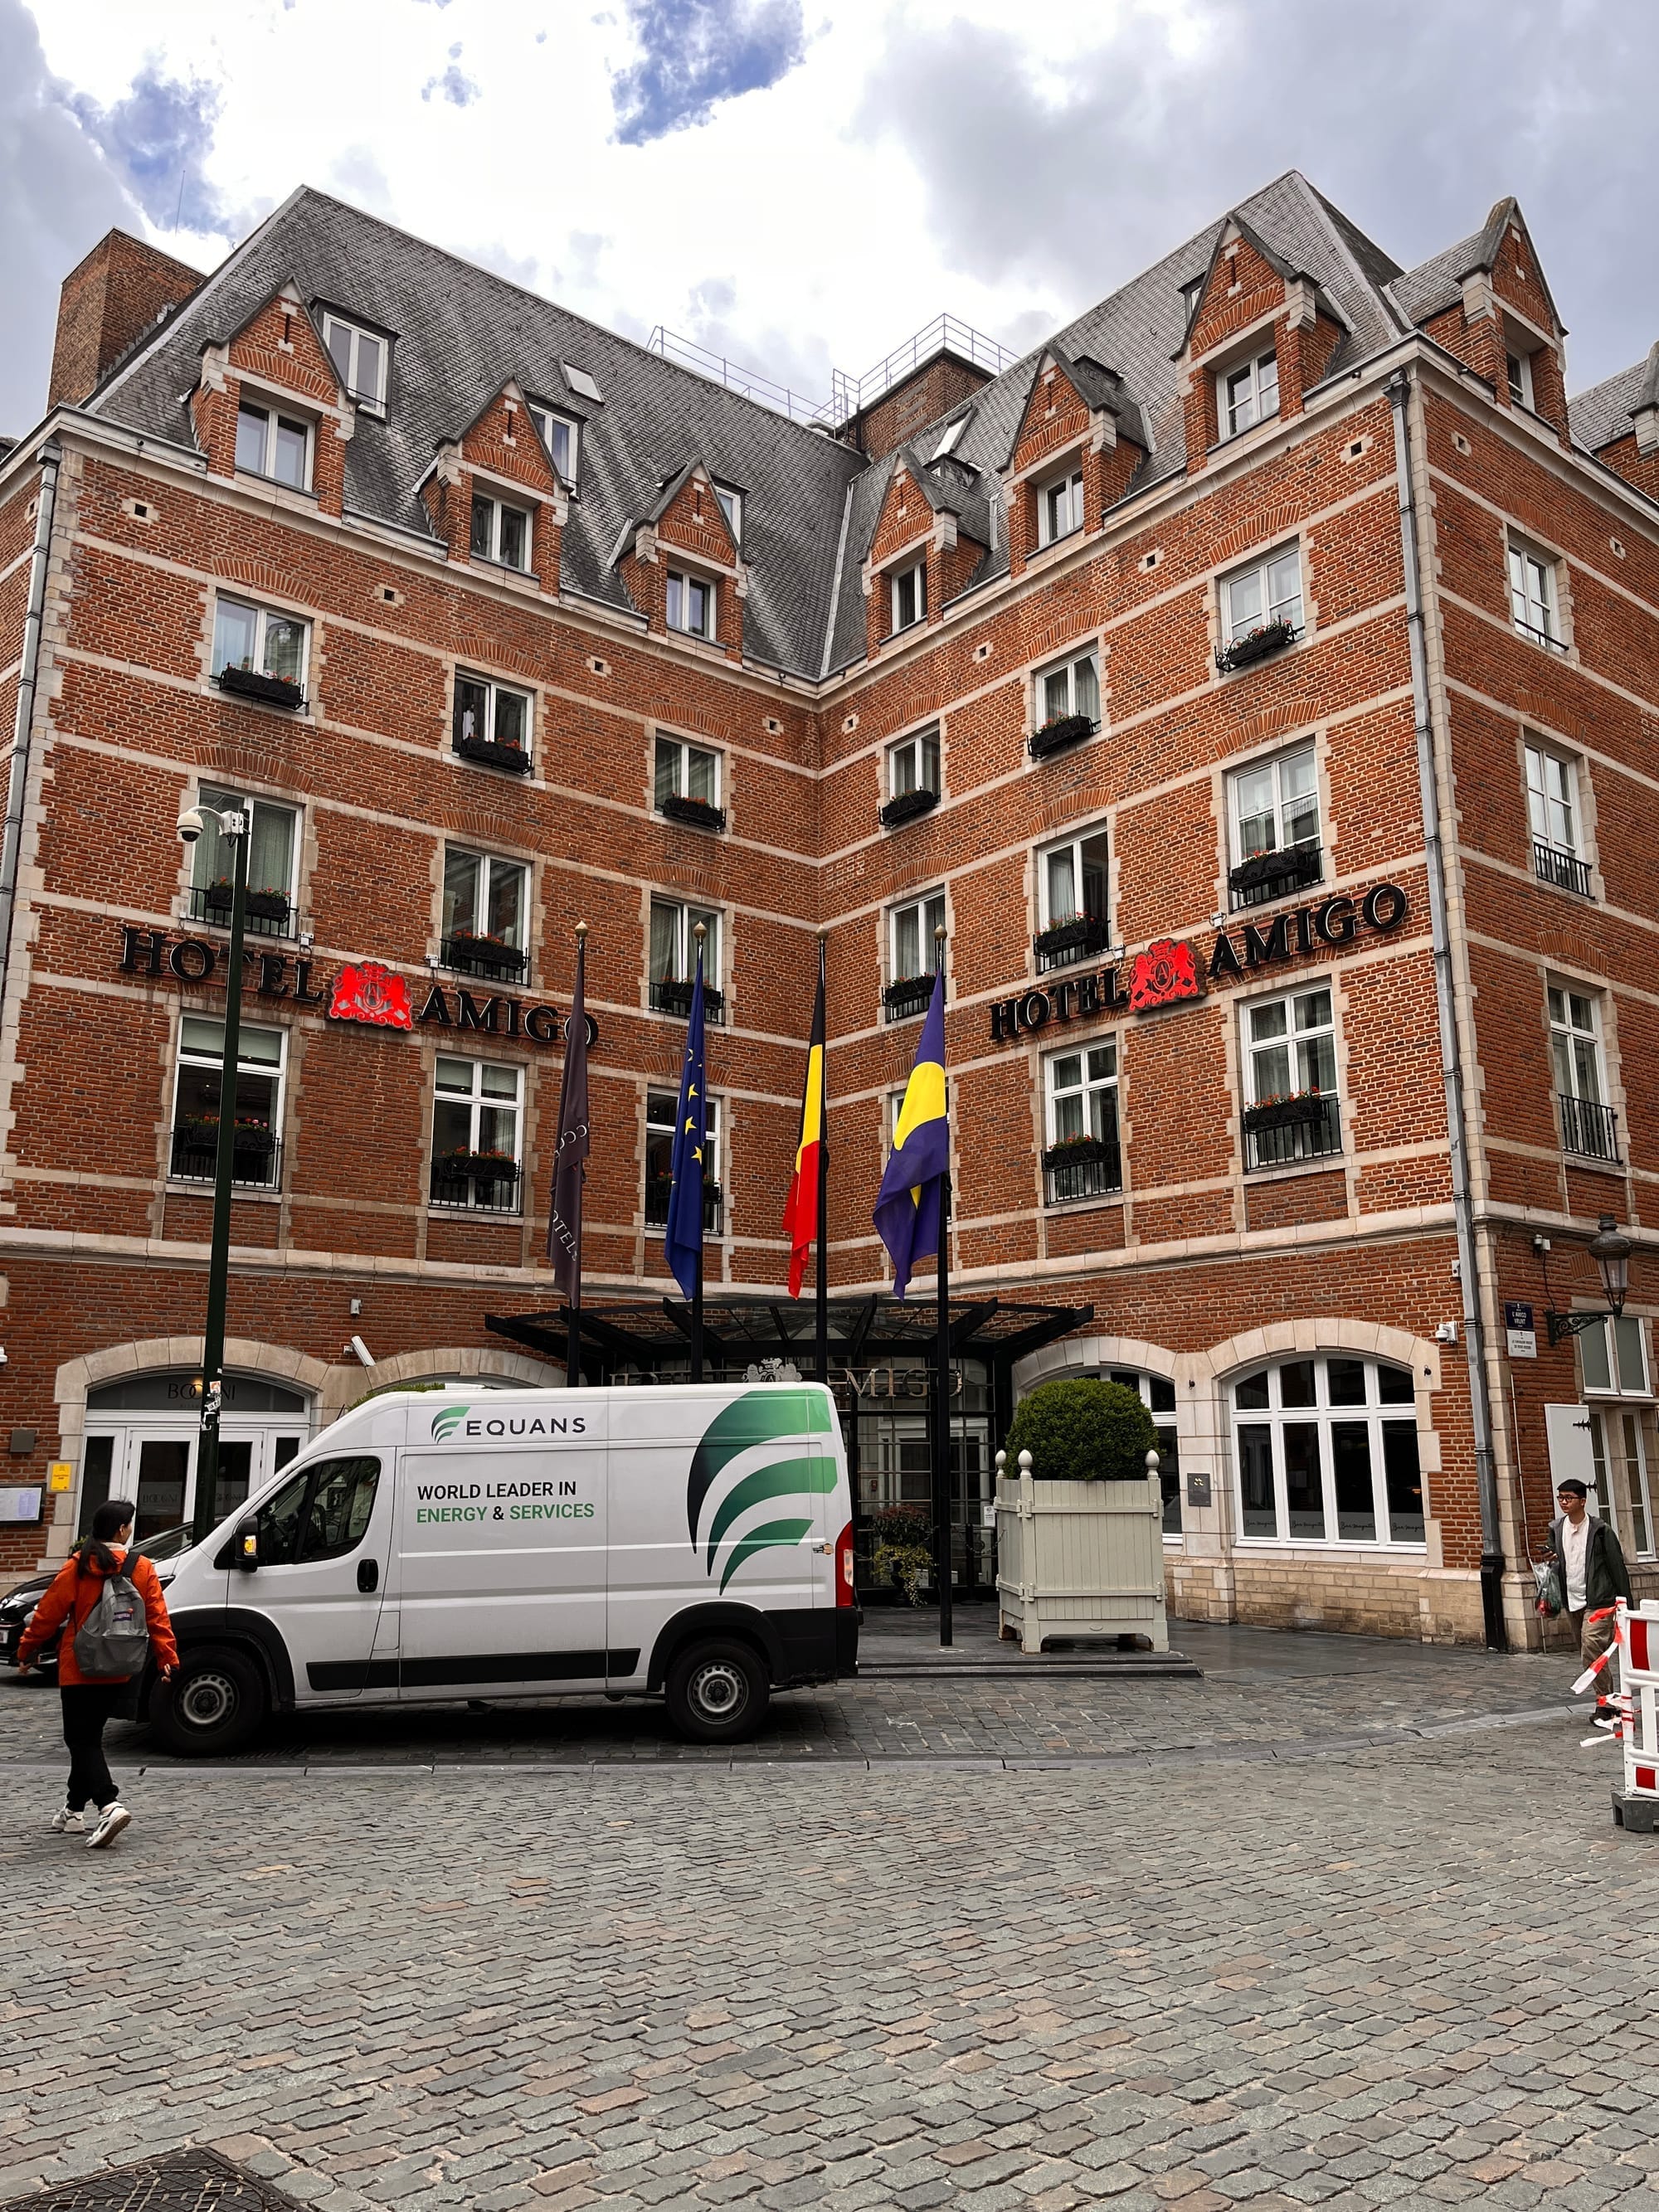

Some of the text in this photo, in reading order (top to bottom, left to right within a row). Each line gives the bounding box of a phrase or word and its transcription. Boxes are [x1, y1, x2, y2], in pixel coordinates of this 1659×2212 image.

[1208, 884, 1408, 977] AMIGO
[417, 986, 599, 1046] AMIGO
[989, 968, 1130, 1040] HOTEL
[466, 1417, 586, 1437] EQUANS
[417, 1480, 577, 1500] WORLD LEADER IN
[416, 1503, 595, 1524] ENERGY & SERVICES
